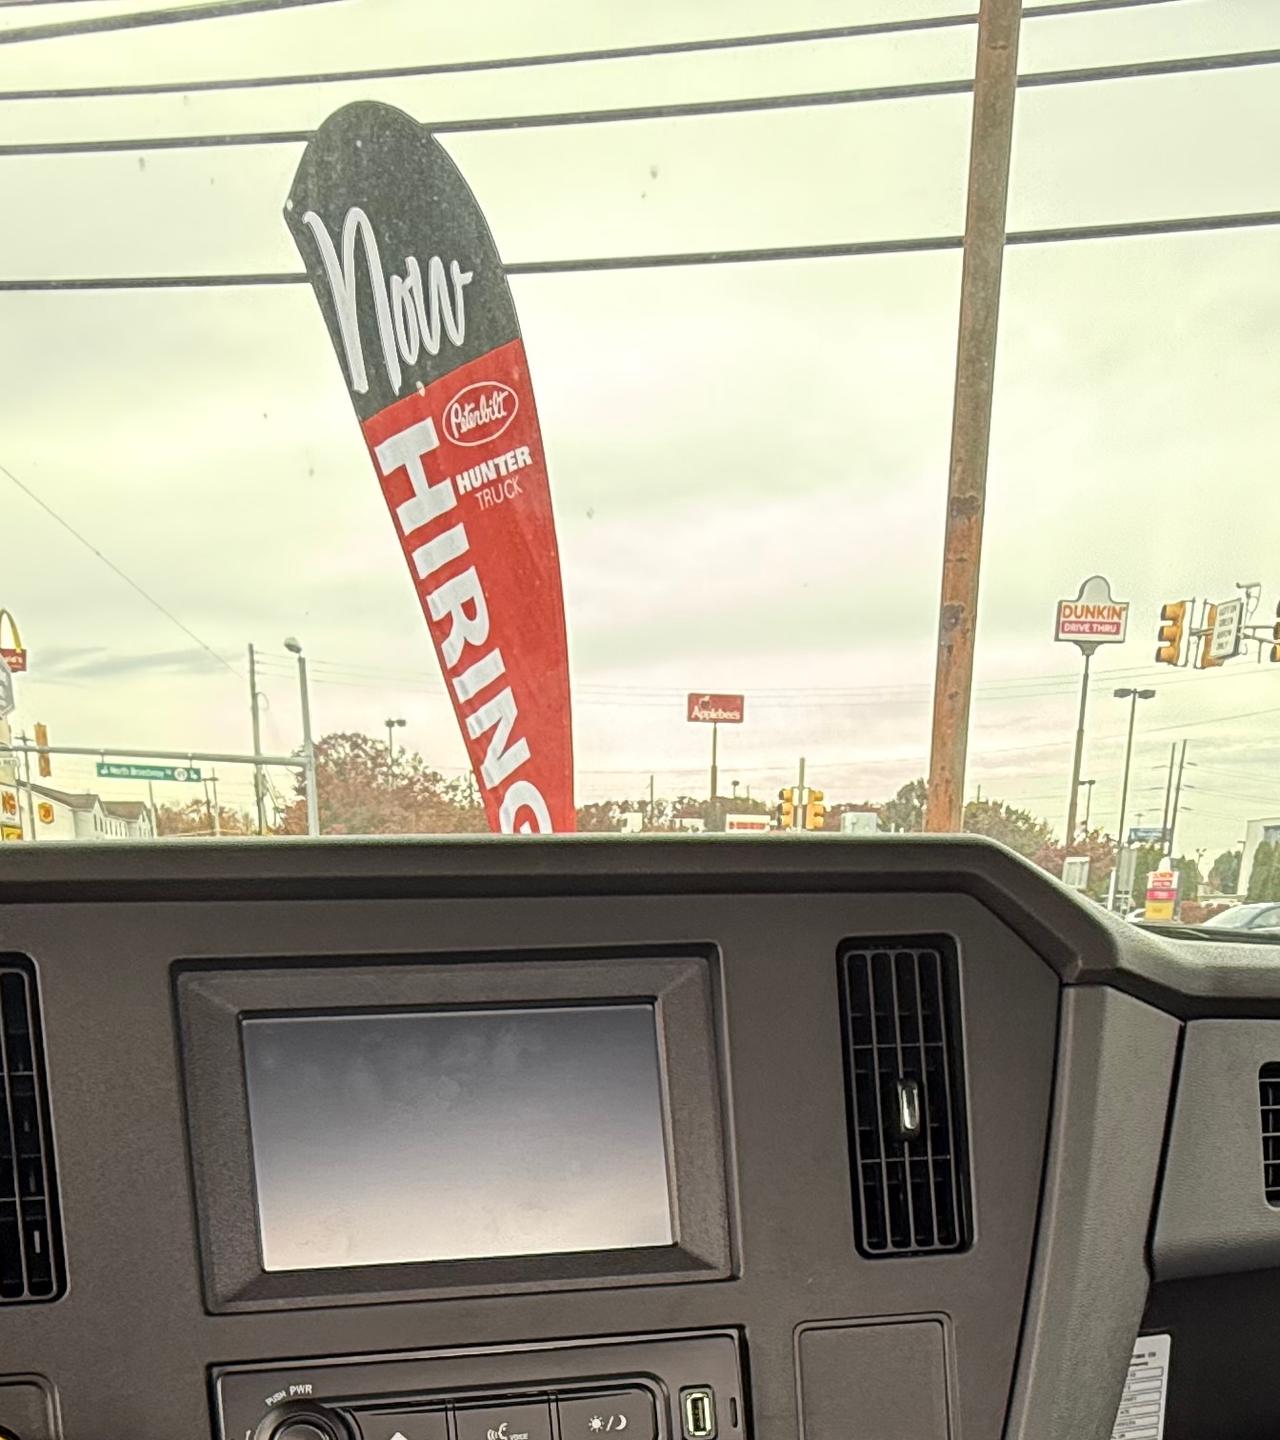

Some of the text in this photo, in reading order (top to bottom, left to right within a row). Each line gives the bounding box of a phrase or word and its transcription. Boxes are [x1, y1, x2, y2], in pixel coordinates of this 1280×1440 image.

[450, 391, 508, 439] Peterbilt
[456, 446, 533, 495] HUNTER
[475, 477, 524, 511] TRUCK
[1064, 623, 1117, 633] DRIVE THRU
[265, 1384, 312, 1406] PUSH PWR
